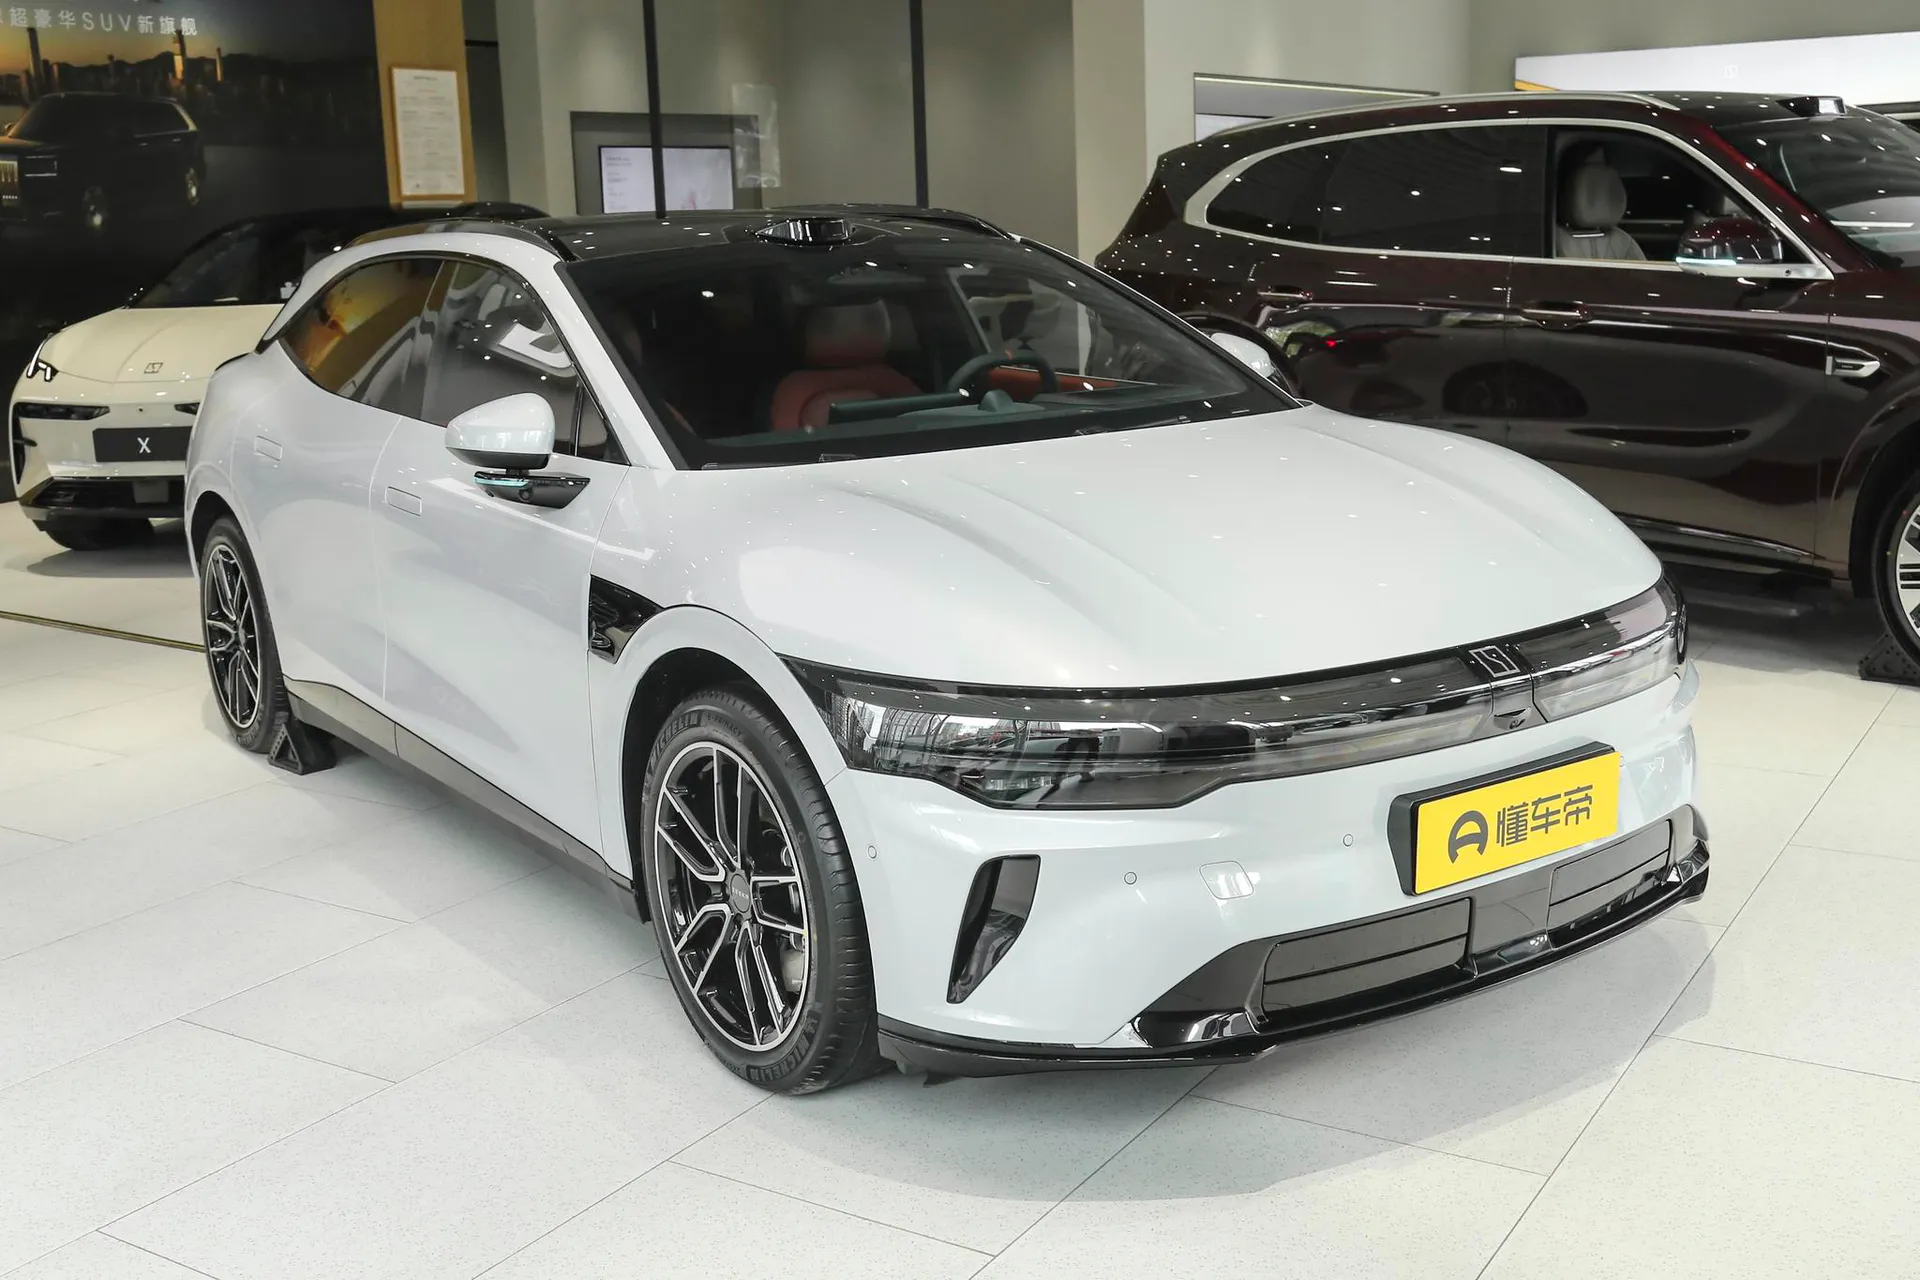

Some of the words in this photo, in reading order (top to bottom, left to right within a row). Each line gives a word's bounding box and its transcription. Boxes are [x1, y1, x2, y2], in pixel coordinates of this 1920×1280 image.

[137, 437, 151, 453] X
[649, 711, 698, 773] MICHELIN
[1496, 784, 1593, 847] 懂车帝
[749, 1033, 810, 1081] MICHELIN
